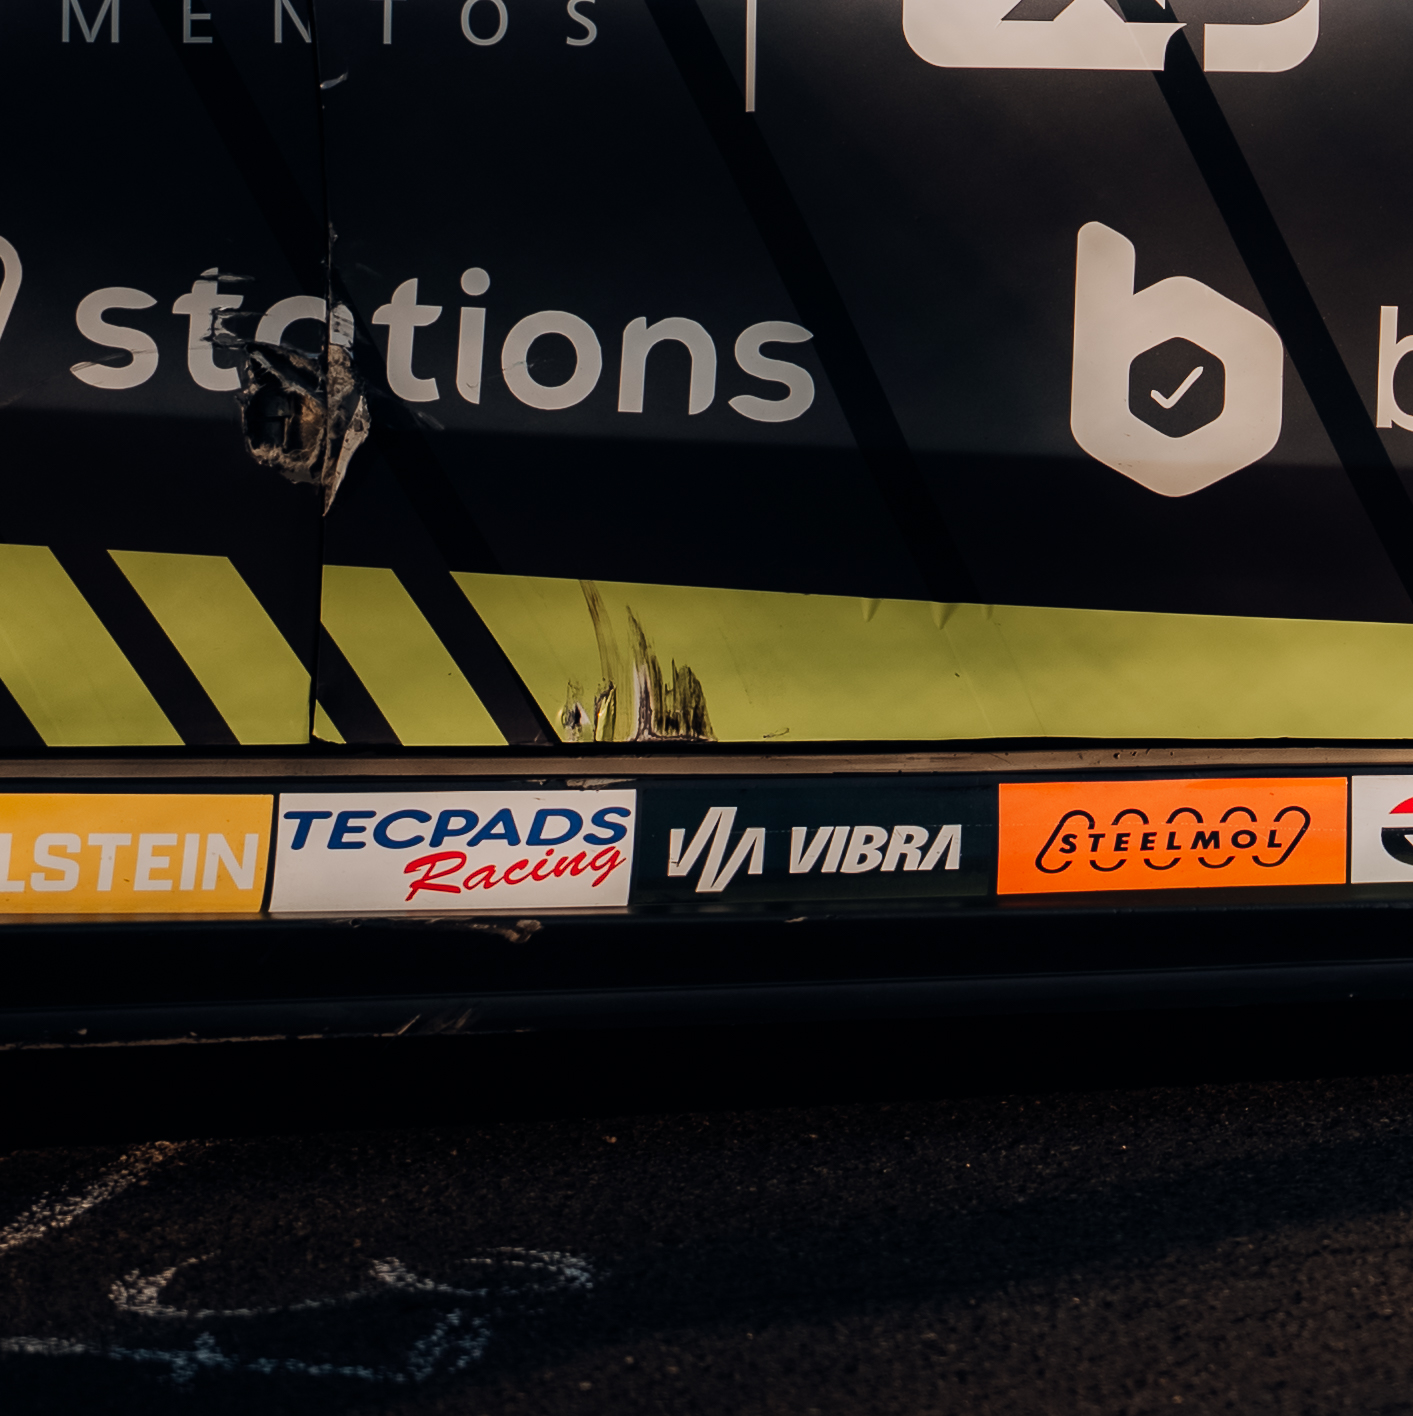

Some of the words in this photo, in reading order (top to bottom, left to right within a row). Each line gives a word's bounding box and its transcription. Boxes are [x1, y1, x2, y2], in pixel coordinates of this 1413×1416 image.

[283, 806, 632, 851] TECPADS
[789, 824, 962, 875] VIBRA
[1058, 828, 1284, 855] STEELMOL
[0, 832, 258, 893] LSTEIN
[404, 845, 627, 903] Racing
